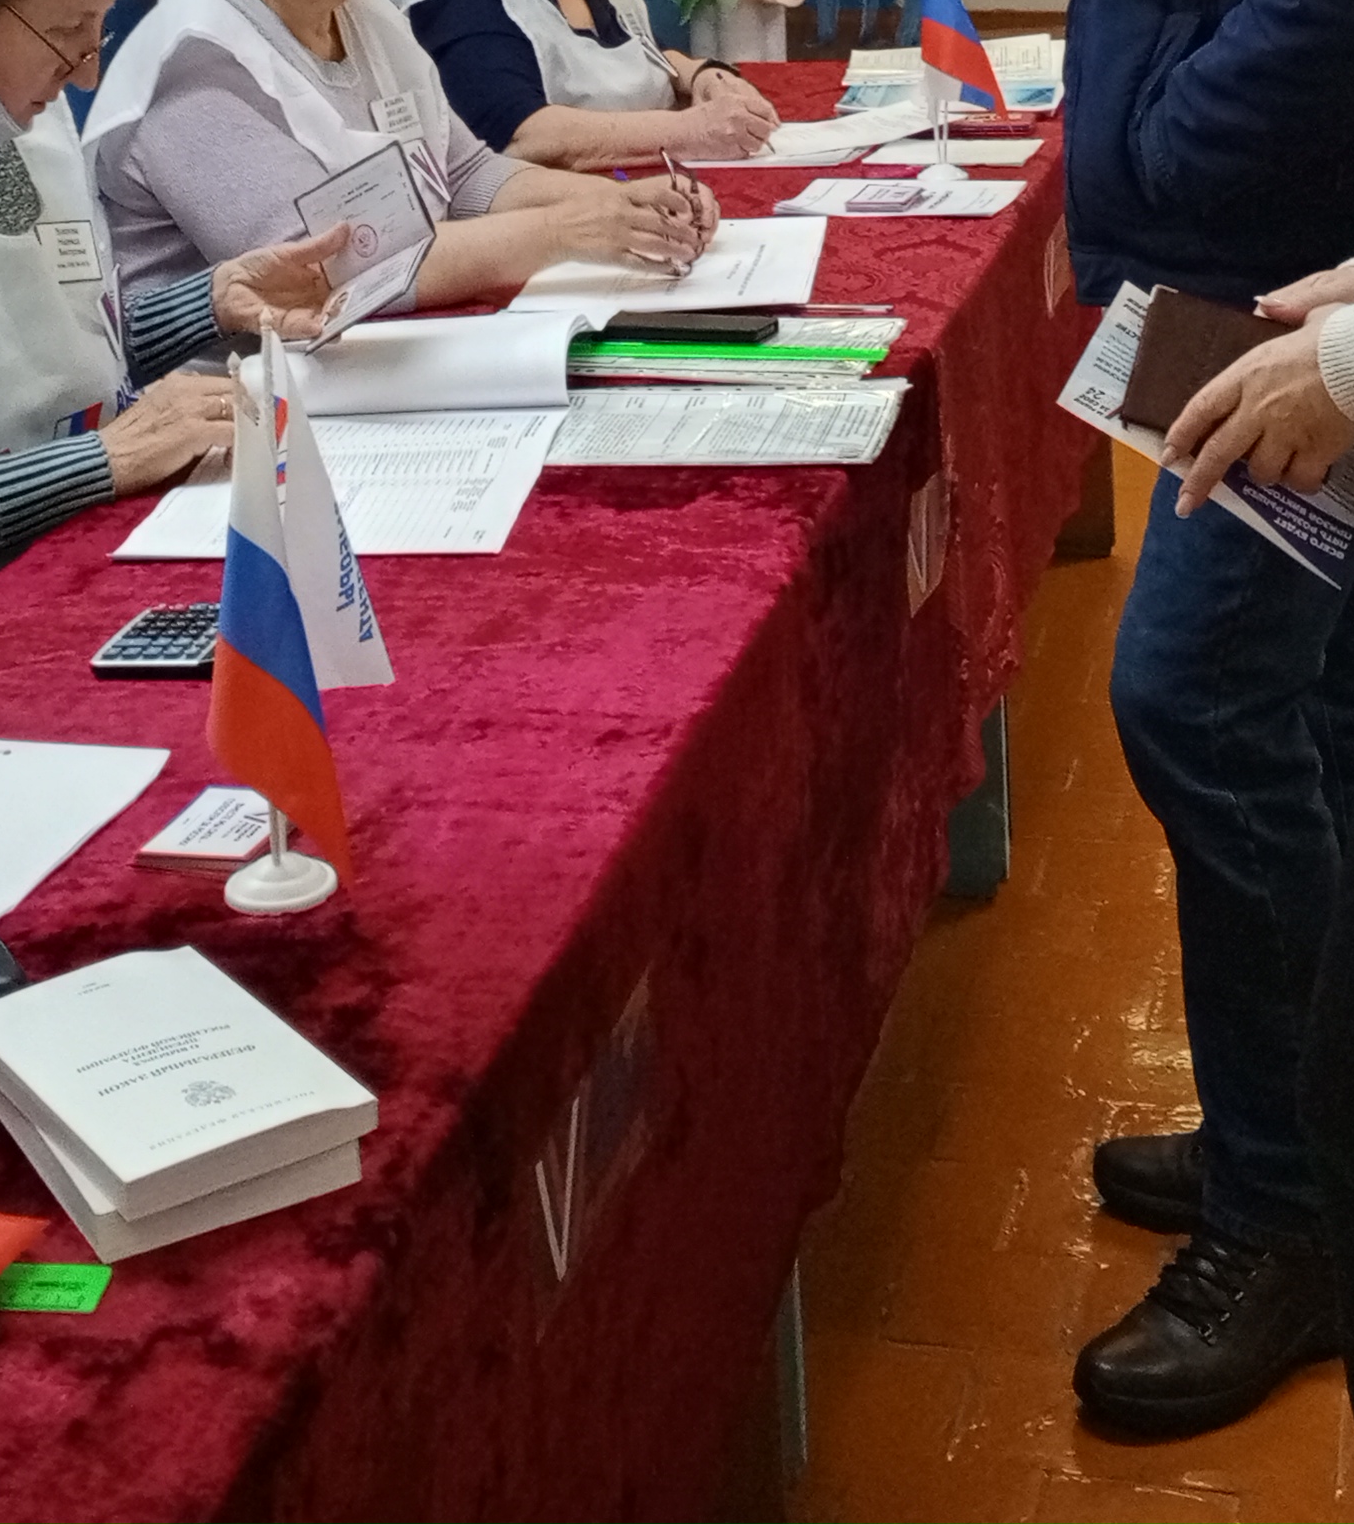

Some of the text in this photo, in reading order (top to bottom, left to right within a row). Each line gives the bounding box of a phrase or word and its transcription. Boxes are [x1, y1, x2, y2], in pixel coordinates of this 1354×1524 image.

[1242, 484, 1318, 535] РОЗЫГРЫШЕЙ
[1274, 516, 1345, 560] ВСЕГО БУДЕТ
[1319, 529, 1349, 550] ПЯТЬ
[97, 1043, 257, 1098] ФЕДЕРАЛЬНЫЙ ЗАКОН
